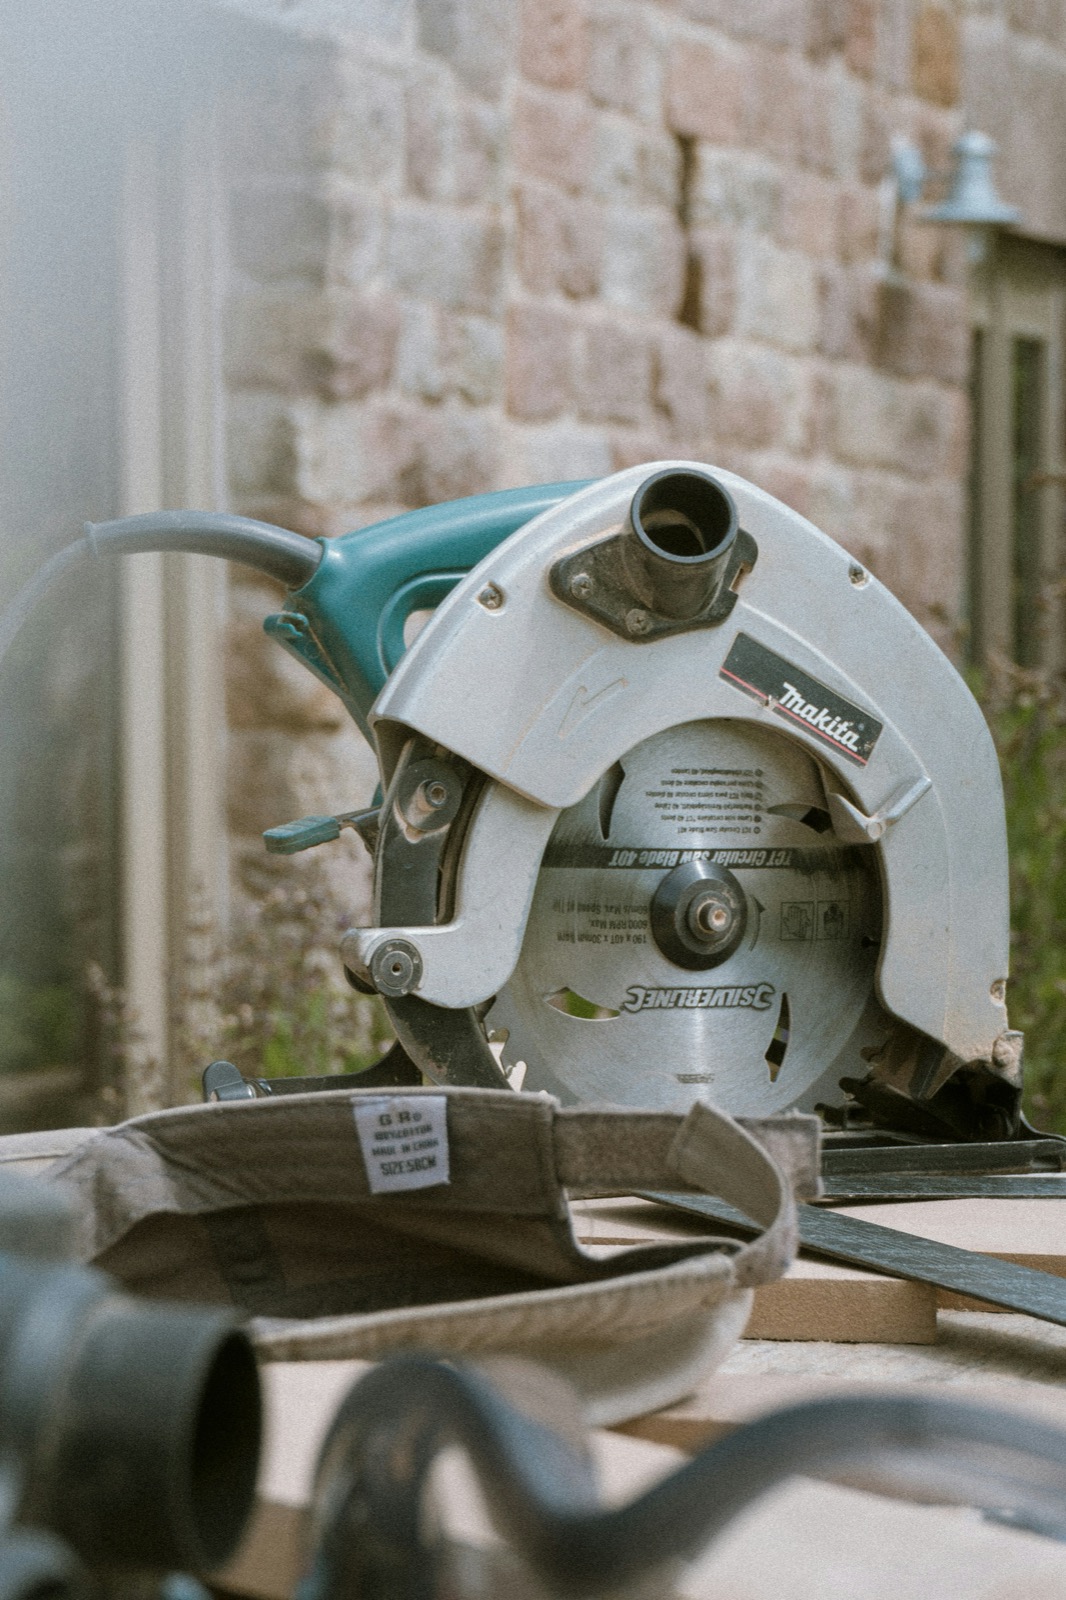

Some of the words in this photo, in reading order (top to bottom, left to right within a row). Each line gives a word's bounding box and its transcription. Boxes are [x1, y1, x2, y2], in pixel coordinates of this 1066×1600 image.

[609, 850, 638, 866] 40T
[639, 850, 679, 867] Blade
[679, 850, 710, 864] Saw
[711, 850, 767, 867] Circular
[767, 850, 792, 866] TCT
[608, 920, 626, 929] RPM
[632, 934, 646, 944] 190
